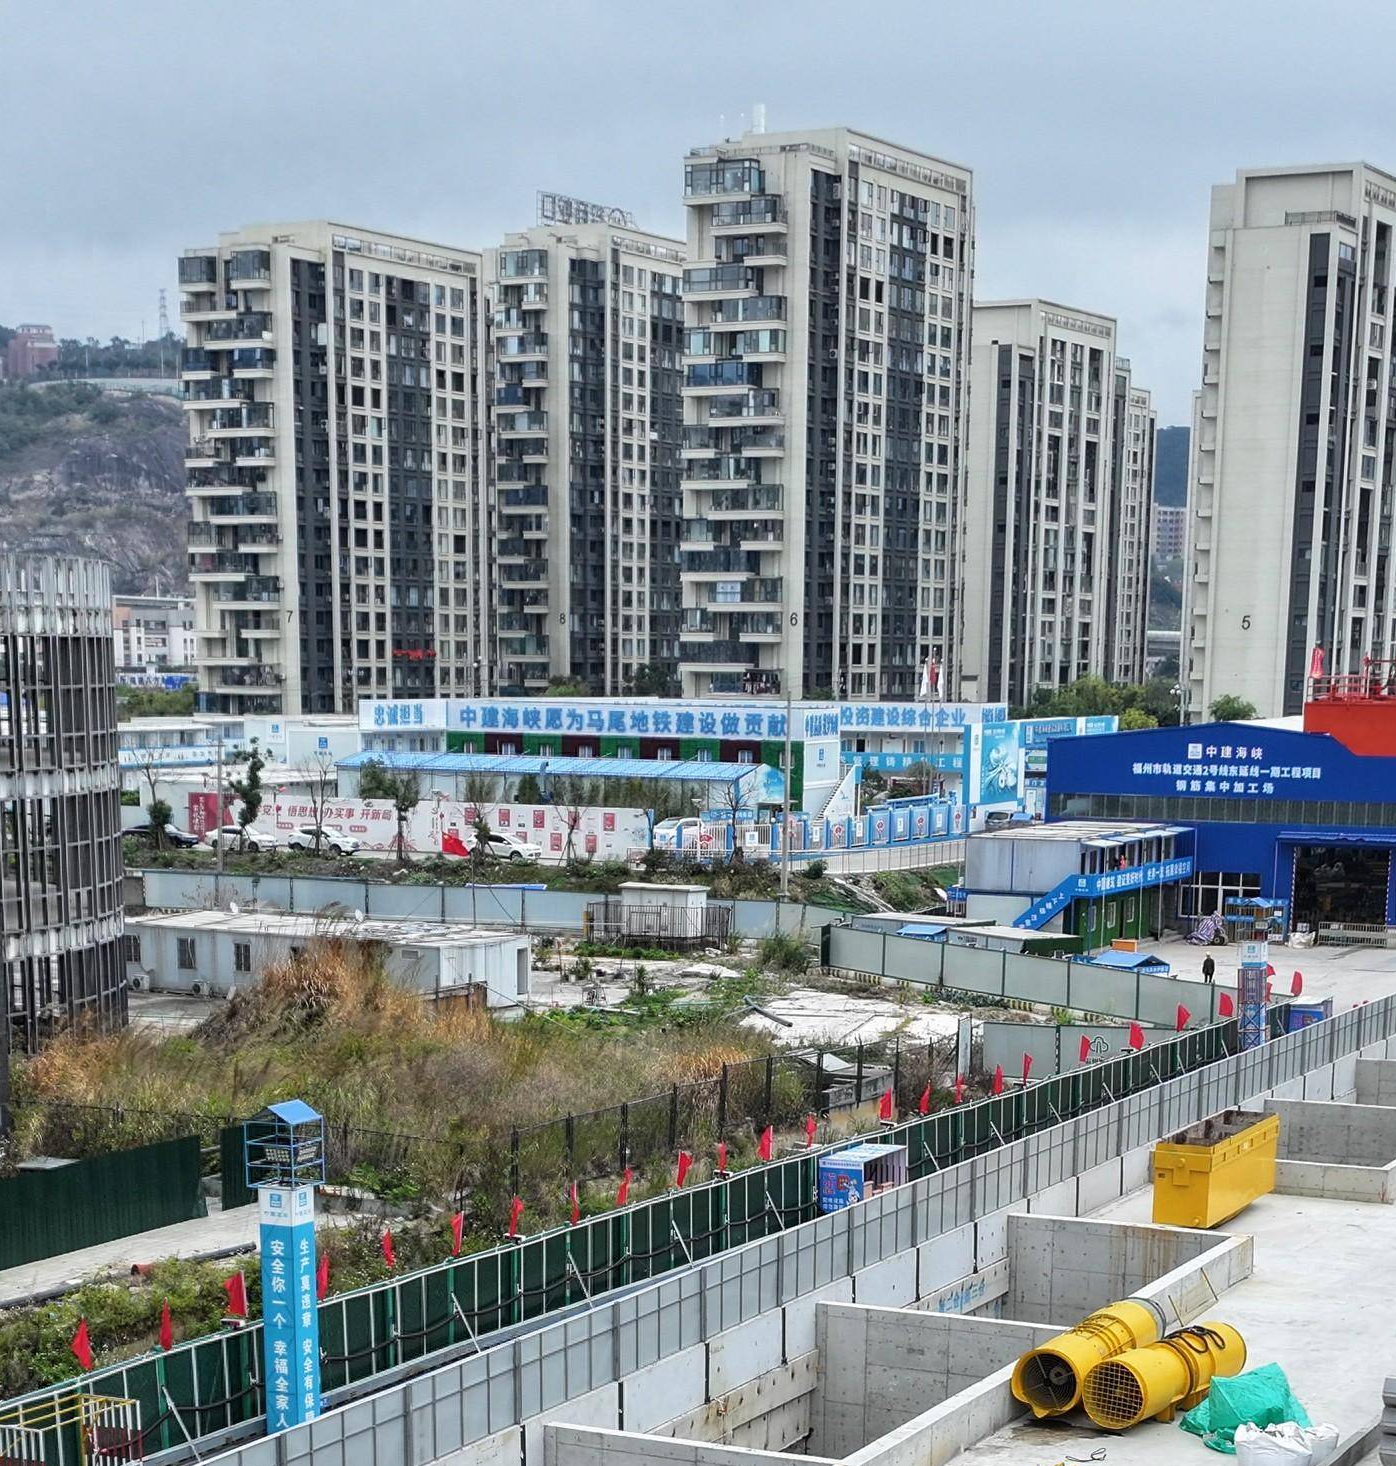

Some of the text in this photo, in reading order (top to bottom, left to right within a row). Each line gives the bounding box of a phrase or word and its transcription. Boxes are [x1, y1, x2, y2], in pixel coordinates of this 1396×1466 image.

[286, 610, 294, 624] 7
[559, 612, 567, 625] 8
[790, 612, 798, 627] 6
[1241, 615, 1251, 631] 5
[374, 704, 423, 725] 忠诚担当
[460, 706, 787, 737] 中建海峡愿为马尾地铁建设做贡献
[840, 706, 966, 728] 投资建设综合企业
[1206, 745, 1263, 760] 中建海峡
[269, 1239, 290, 1430] 安全你一个 幸福全家人
